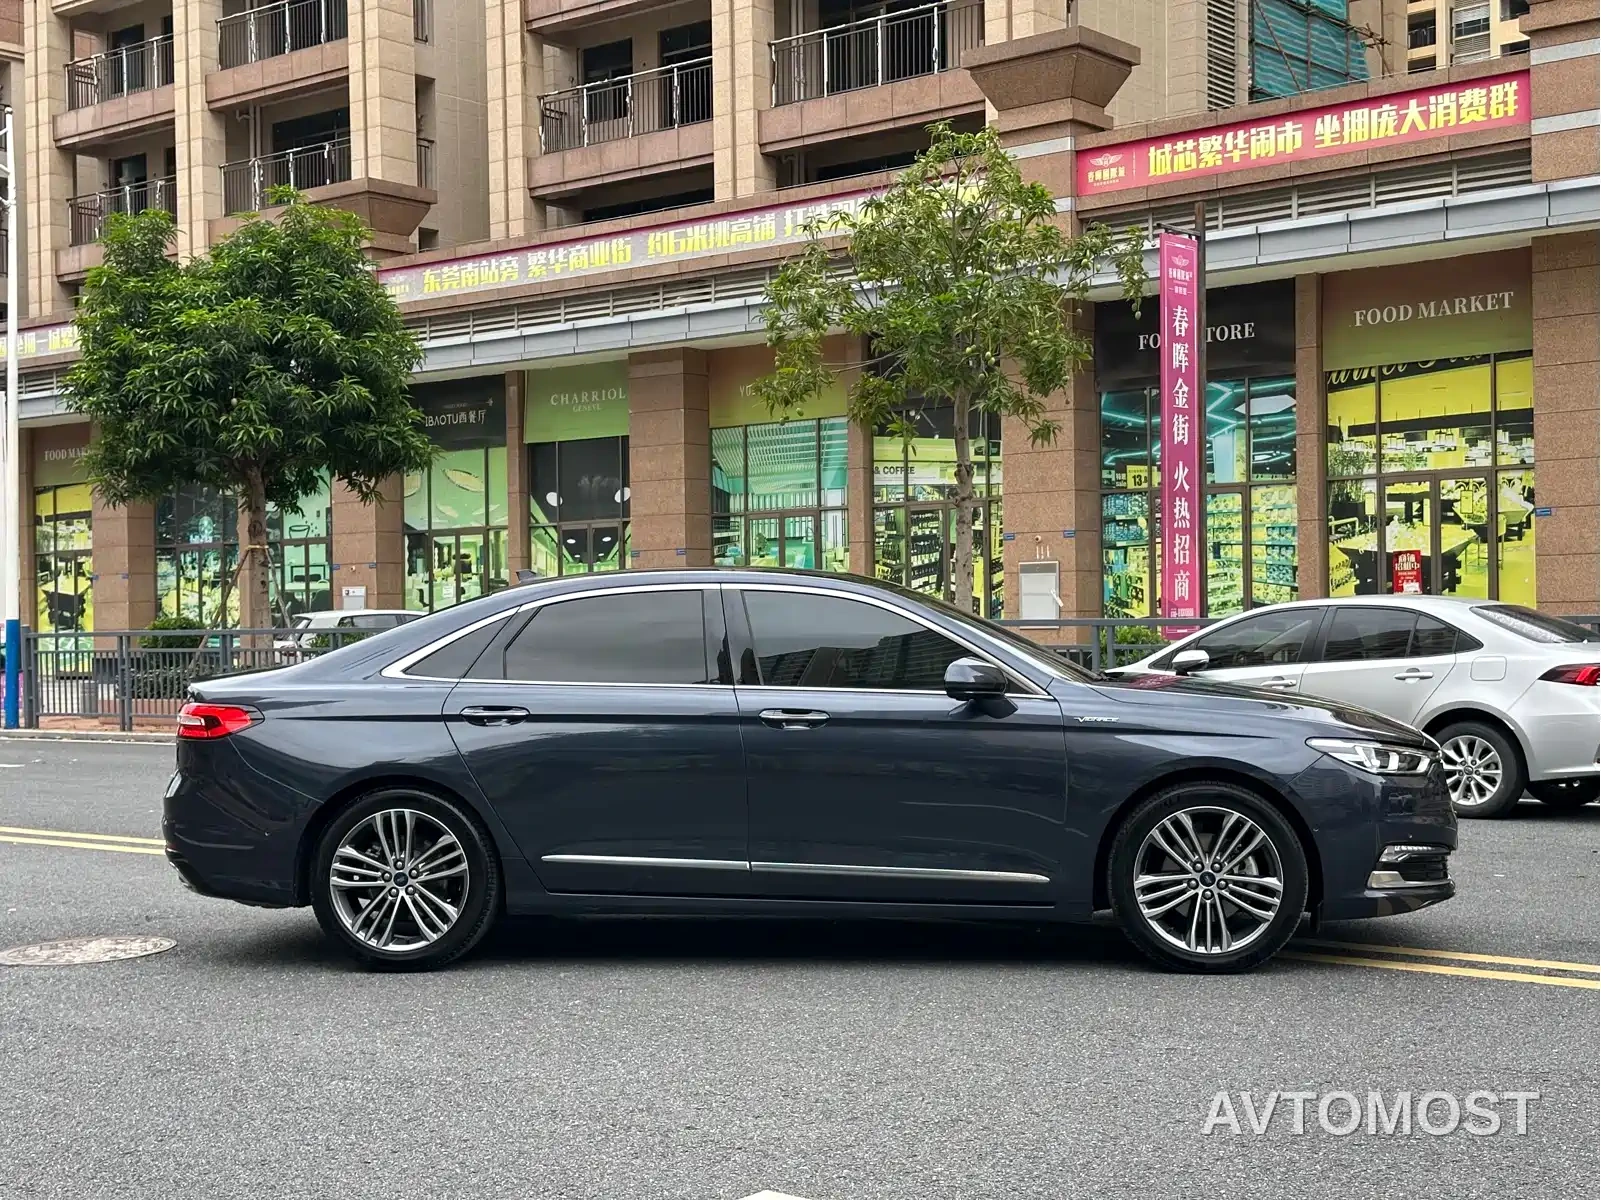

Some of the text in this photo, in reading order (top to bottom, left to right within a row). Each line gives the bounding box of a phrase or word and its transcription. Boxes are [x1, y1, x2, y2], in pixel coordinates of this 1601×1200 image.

[1148, 81, 1518, 177] 城芯繁华闹市 坐拥庞大消费群
[422, 256, 519, 294] 东莞南站旁
[527, 237, 632, 278] 繁华商业街
[647, 212, 776, 259] 约6米挑高铺
[1205, 322, 1255, 343] TORE
[1354, 291, 1514, 327] FOOD MARKET
[550, 387, 626, 406] CHARRIOL
[1172, 304, 1189, 446] 春晖金街
[44, 448, 67, 461] FOOD
[1173, 460, 1190, 602] 火热招商
